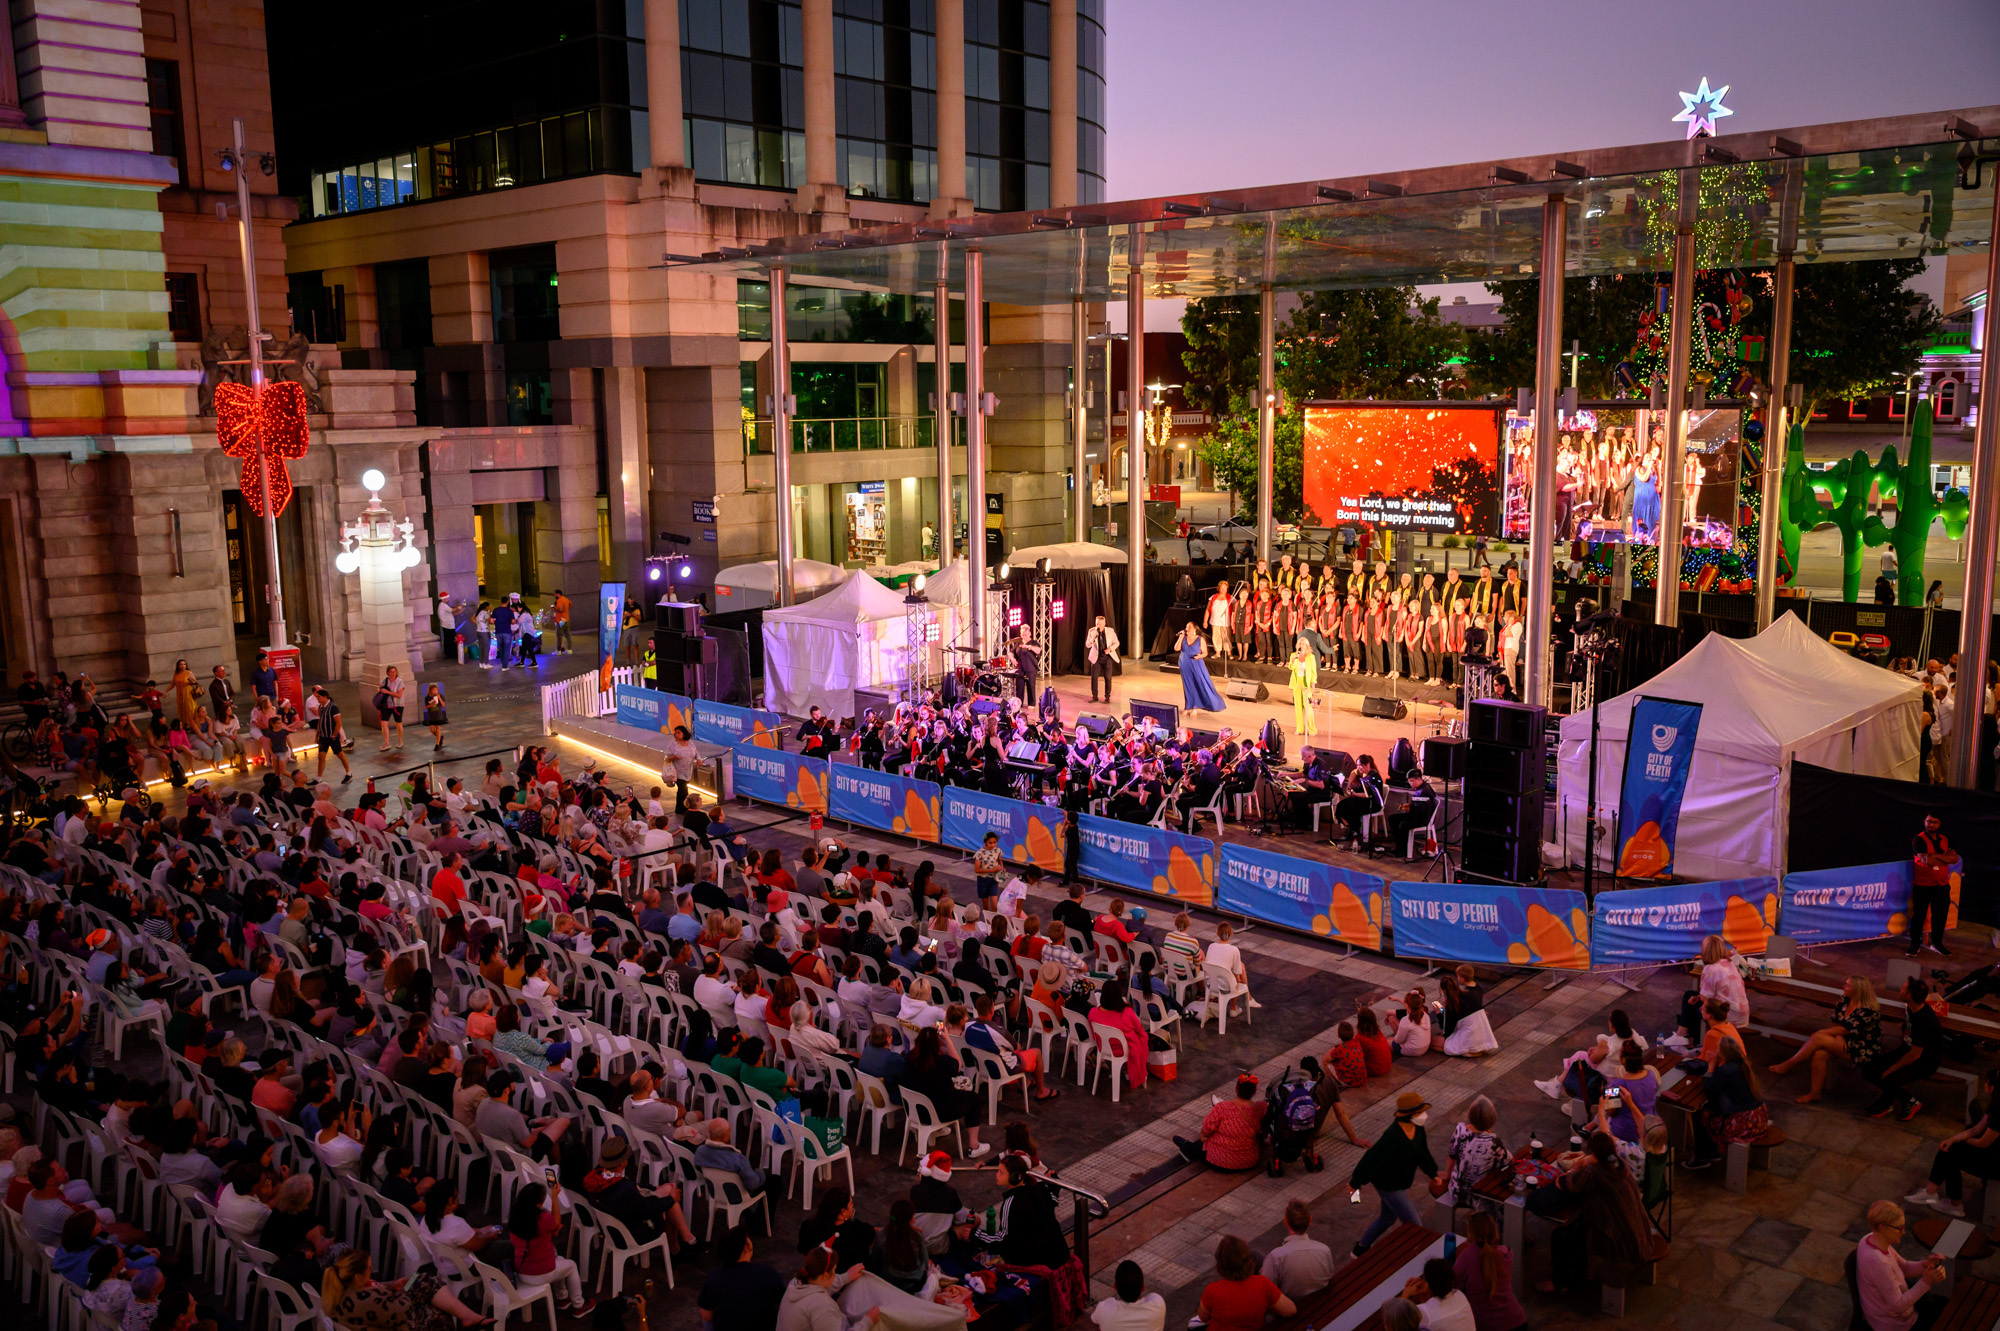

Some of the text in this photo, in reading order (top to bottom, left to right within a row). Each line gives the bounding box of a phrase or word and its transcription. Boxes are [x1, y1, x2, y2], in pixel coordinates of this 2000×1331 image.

[1340, 497, 1452, 512] Yea Lord, we greet thee
[1337, 510, 1455, 528] Born this happy morning
[620, 695, 658, 713] CITY OF PERTH
[698, 711, 742, 730] CITY OF PERTH
[738, 755, 785, 777] CITY OF PERTH
[1648, 753, 1673, 766] CITY OF
[1646, 764, 1671, 778] PERTH
[836, 775, 890, 801] CITY OF PERTH
[950, 800, 1010, 828] CITY OF PERTH
[1079, 828, 1149, 858] CITY OF PERTH
[1228, 860, 1309, 895] CITY OF PERTH
[1278, 890, 1289, 898] City
[1294, 894, 1308, 902] Light
[1793, 882, 1887, 906] CITY OF PERTH
[1401, 899, 1498, 923] CITY OF PERTH
[1606, 902, 1700, 926] CITY OF PERTH
